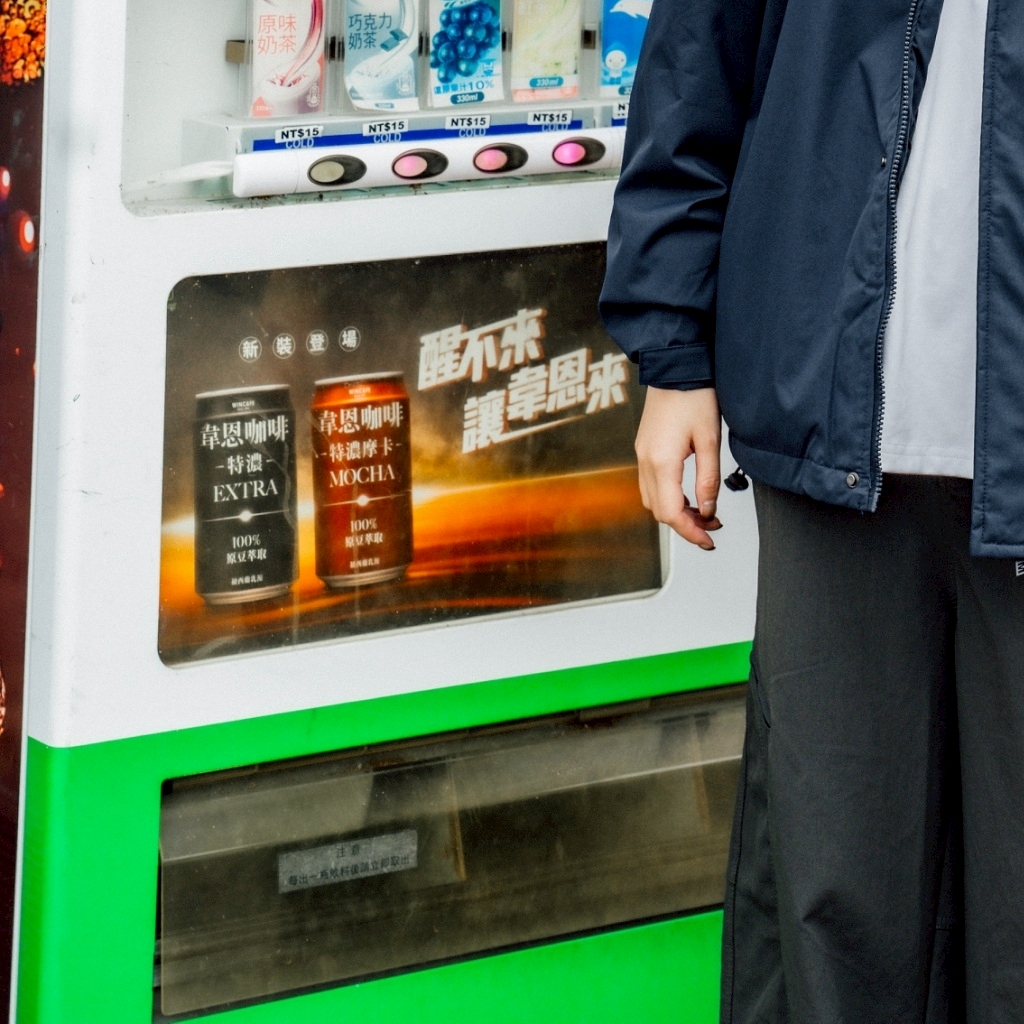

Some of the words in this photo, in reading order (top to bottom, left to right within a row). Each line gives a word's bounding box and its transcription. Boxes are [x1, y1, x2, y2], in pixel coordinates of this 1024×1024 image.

[257, 14, 296, 34] 原味
[348, 12, 393, 32] 巧克力
[257, 34, 296, 55] 奶茶
[348, 32, 377, 50] 奶茶
[451, 116, 486, 127] NT$15
[533, 113, 567, 123] NT$15
[281, 128, 320, 140] NT$15
[368, 121, 405, 133] NT$15
[459, 128, 486, 137] COLD
[541, 123, 569, 132] COLD
[286, 138, 314, 149] COLD
[373, 132, 402, 143] COLD
[242, 329, 358, 359] 新裝登場
[418, 308, 544, 391] 醒不來
[319, 402, 404, 436] 韋恩咖啡
[200, 415, 289, 450] 韋恩咖啡
[329, 464, 395, 488] MOCHA
[213, 479, 278, 502] EXTRA
[350, 518, 377, 532] 100%
[232, 534, 261, 549] 100%
[226, 549, 267, 565] 原豆萃取
